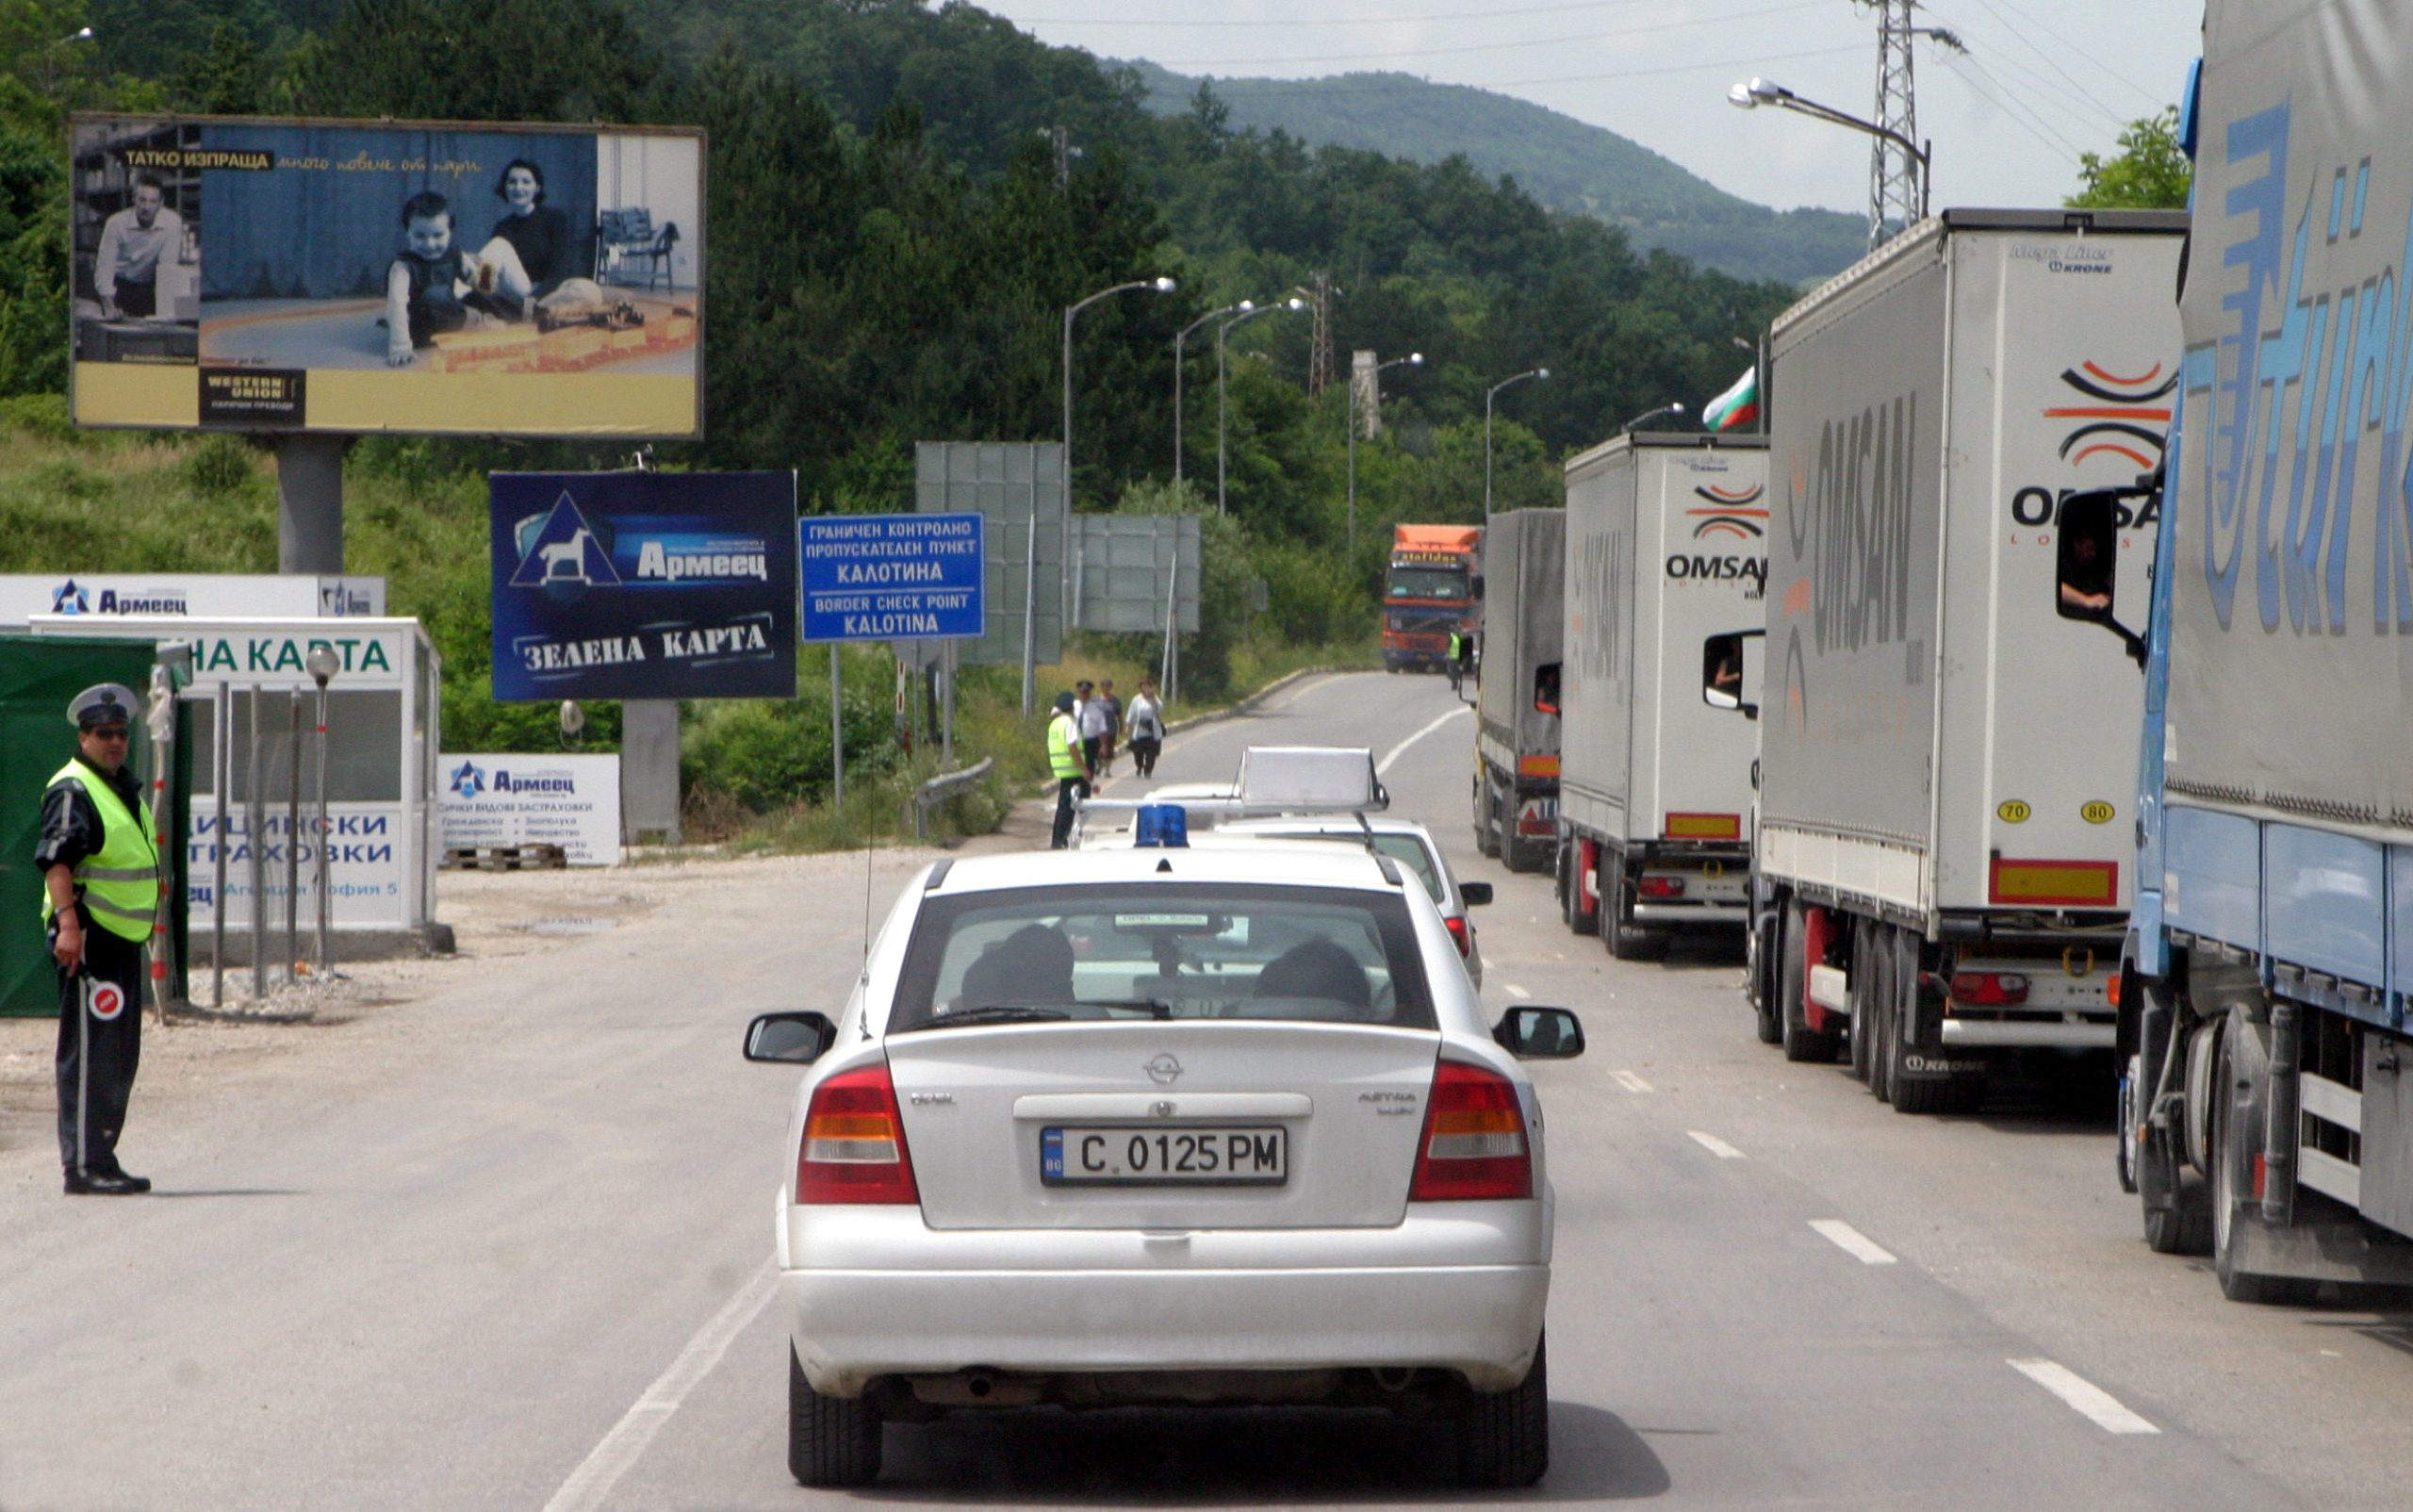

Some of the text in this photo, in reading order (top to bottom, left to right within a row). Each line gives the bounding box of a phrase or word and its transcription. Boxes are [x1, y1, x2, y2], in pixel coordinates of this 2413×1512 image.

[125, 150, 180, 166] ТАТКО
[184, 152, 269, 171] ИЗПРАЩА
[2063, 263, 2112, 274] KRONE
[208, 376, 282, 387] WESTERN
[232, 387, 282, 398] UNION
[810, 521, 972, 540] ГРАНИЧЕН КОНТРОЛНО
[1814, 390, 1916, 659] OMSAN
[806, 540, 977, 558] ПРОПУСКАТЕЛЕН ПУНКТ
[637, 541, 767, 582] Армеец
[838, 562, 943, 583] КАЛОТИНА
[98, 589, 188, 616] Армеец
[815, 594, 968, 612] BORDER CHECK POINT
[845, 614, 939, 634] KALOTINA
[524, 623, 766, 671] ЗЕЛЕНА КАРТА
[494, 770, 575, 795] Армеец
[518, 803, 593, 813] ЗАСТРАХОВКИ
[2006, 805, 2024, 818] 70
[2089, 806, 2107, 818] 80
[387, 882, 398, 896] 5
[1228, 1135, 1277, 1172] PM
